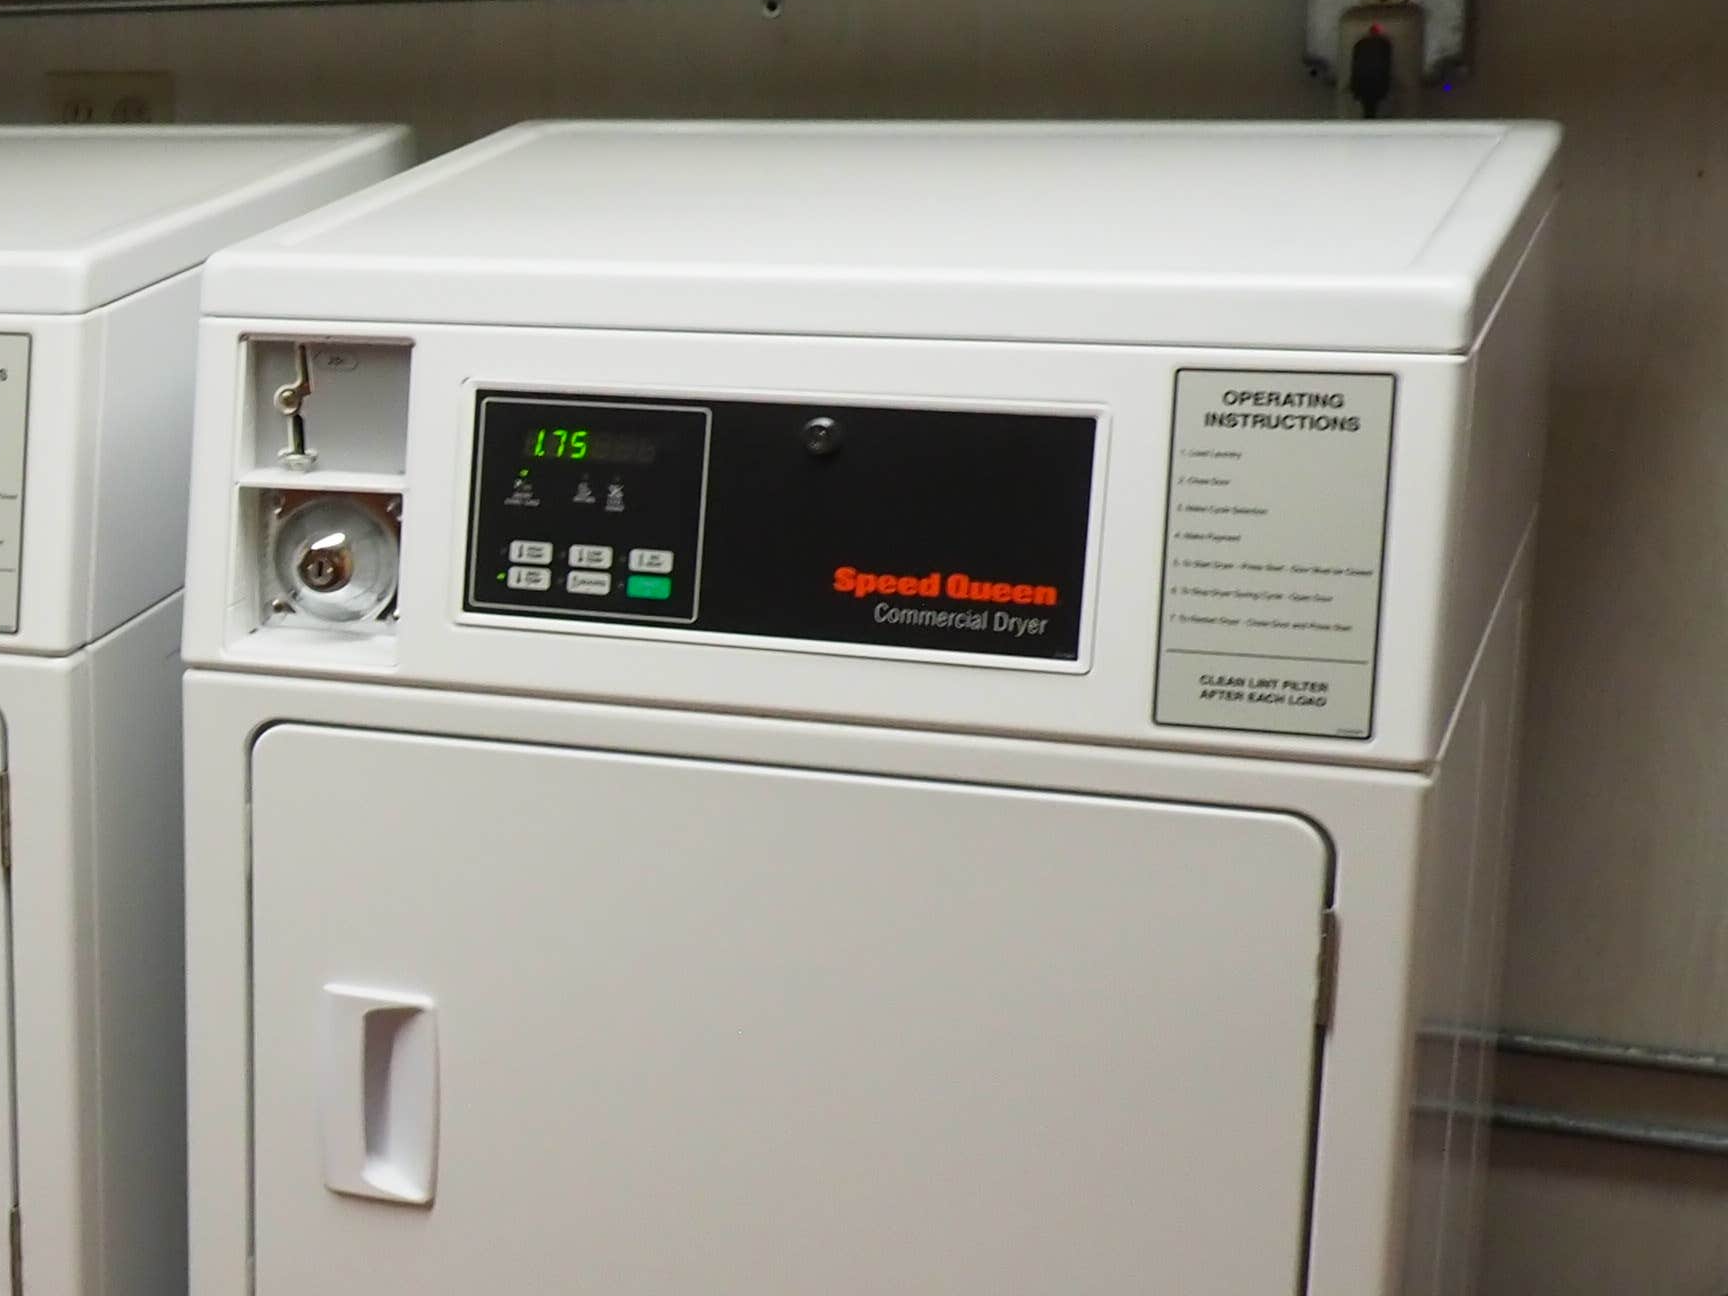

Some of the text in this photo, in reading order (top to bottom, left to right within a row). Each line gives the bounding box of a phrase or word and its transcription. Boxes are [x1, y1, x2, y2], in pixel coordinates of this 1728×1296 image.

[1221, 389, 1345, 410] OPERATING
[1204, 412, 1362, 434] INSTRUCTIONS
[833, 565, 1058, 606] Speed Queen
[874, 602, 1050, 638] Commercial Dryer
[1199, 674, 1329, 693] CLEAN LINT FILTER
[1199, 689, 1328, 708] AFTER EACH LOAD
